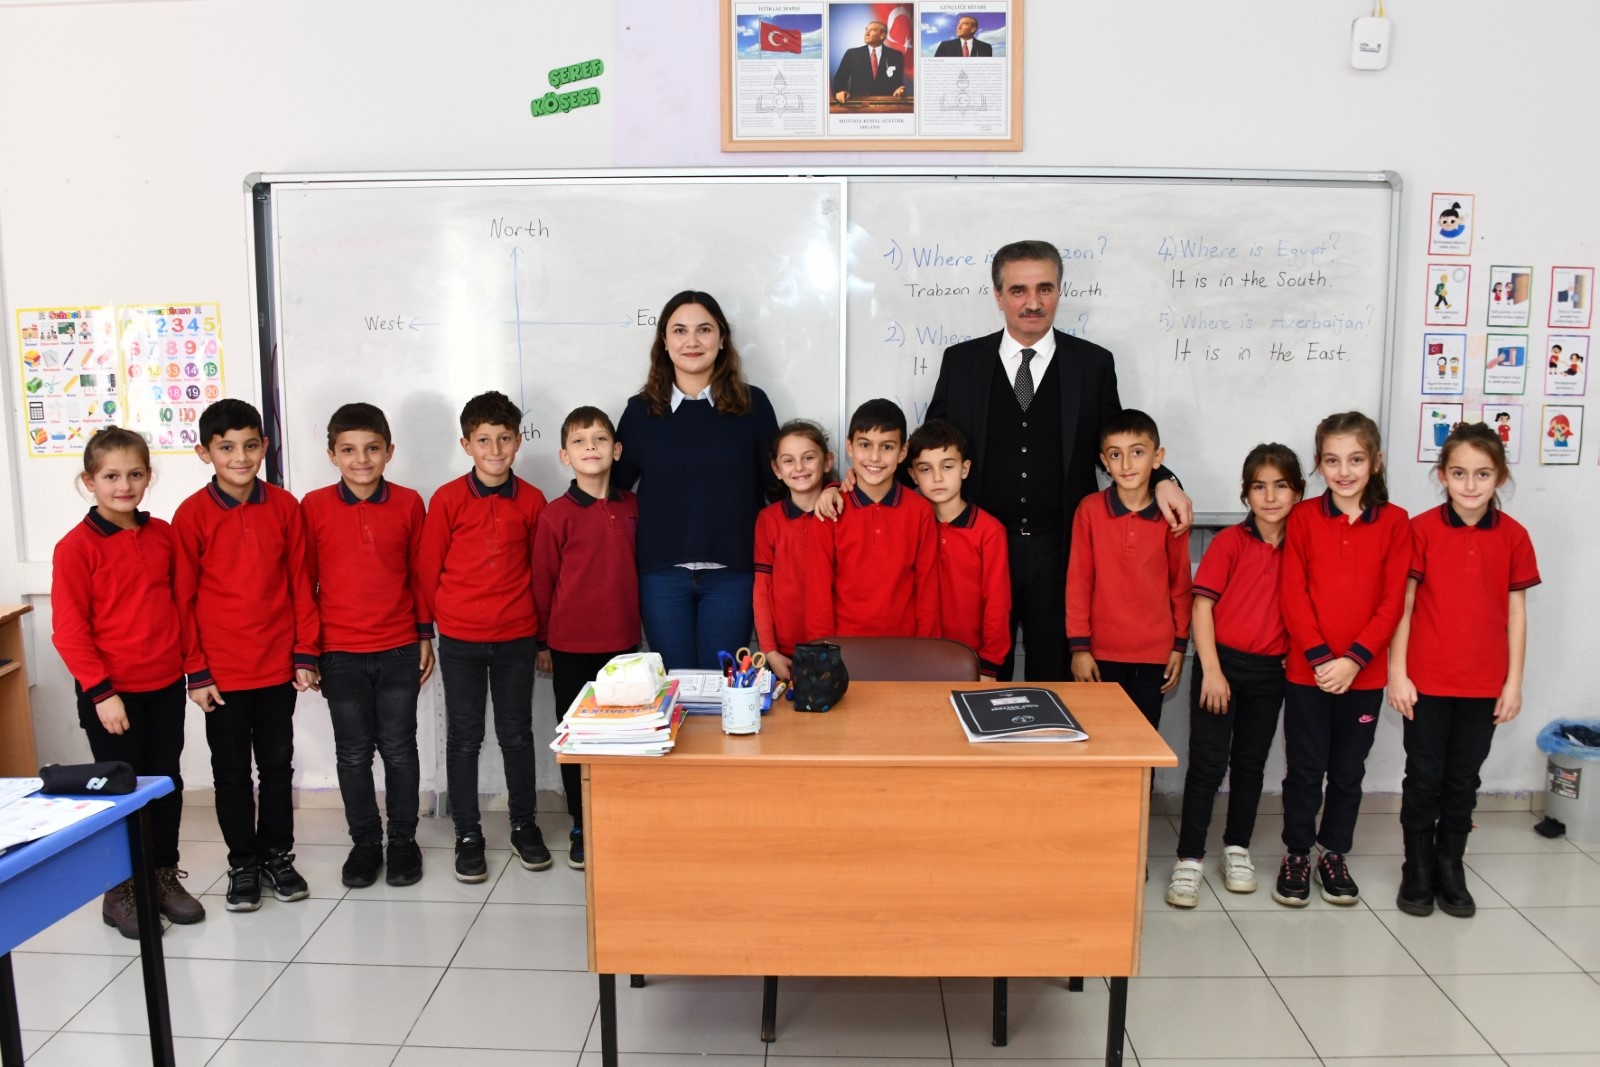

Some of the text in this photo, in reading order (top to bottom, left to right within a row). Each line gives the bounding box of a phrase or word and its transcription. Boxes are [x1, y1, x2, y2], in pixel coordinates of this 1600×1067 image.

[549, 59, 602, 89] ŞEREF
[531, 87, 600, 116] KÖŞESİ
[490, 218, 549, 238] North
[913, 244, 976, 267] Where
[1062, 236, 1107, 263] zon?
[1180, 236, 1239, 258] Where
[1250, 242, 1263, 258] is
[1172, 269, 1333, 288] It is in the South.
[904, 282, 1107, 298] Trabzon is North.
[49, 310, 82, 319] School
[364, 315, 406, 331] West
[638, 308, 657, 326] Ea
[1182, 311, 1230, 330] Where
[1240, 315, 1253, 330] is
[172, 318, 184, 333] 3
[187, 318, 200, 332] 4
[204, 317, 216, 332] 5
[166, 340, 178, 355] 8
[184, 340, 197, 355] 9
[1174, 338, 1350, 362] It is in the East.
[186, 366, 197, 375] 14
[204, 365, 215, 374] 15
[914, 356, 928, 375] It
[169, 387, 217, 397] 18 19 20
